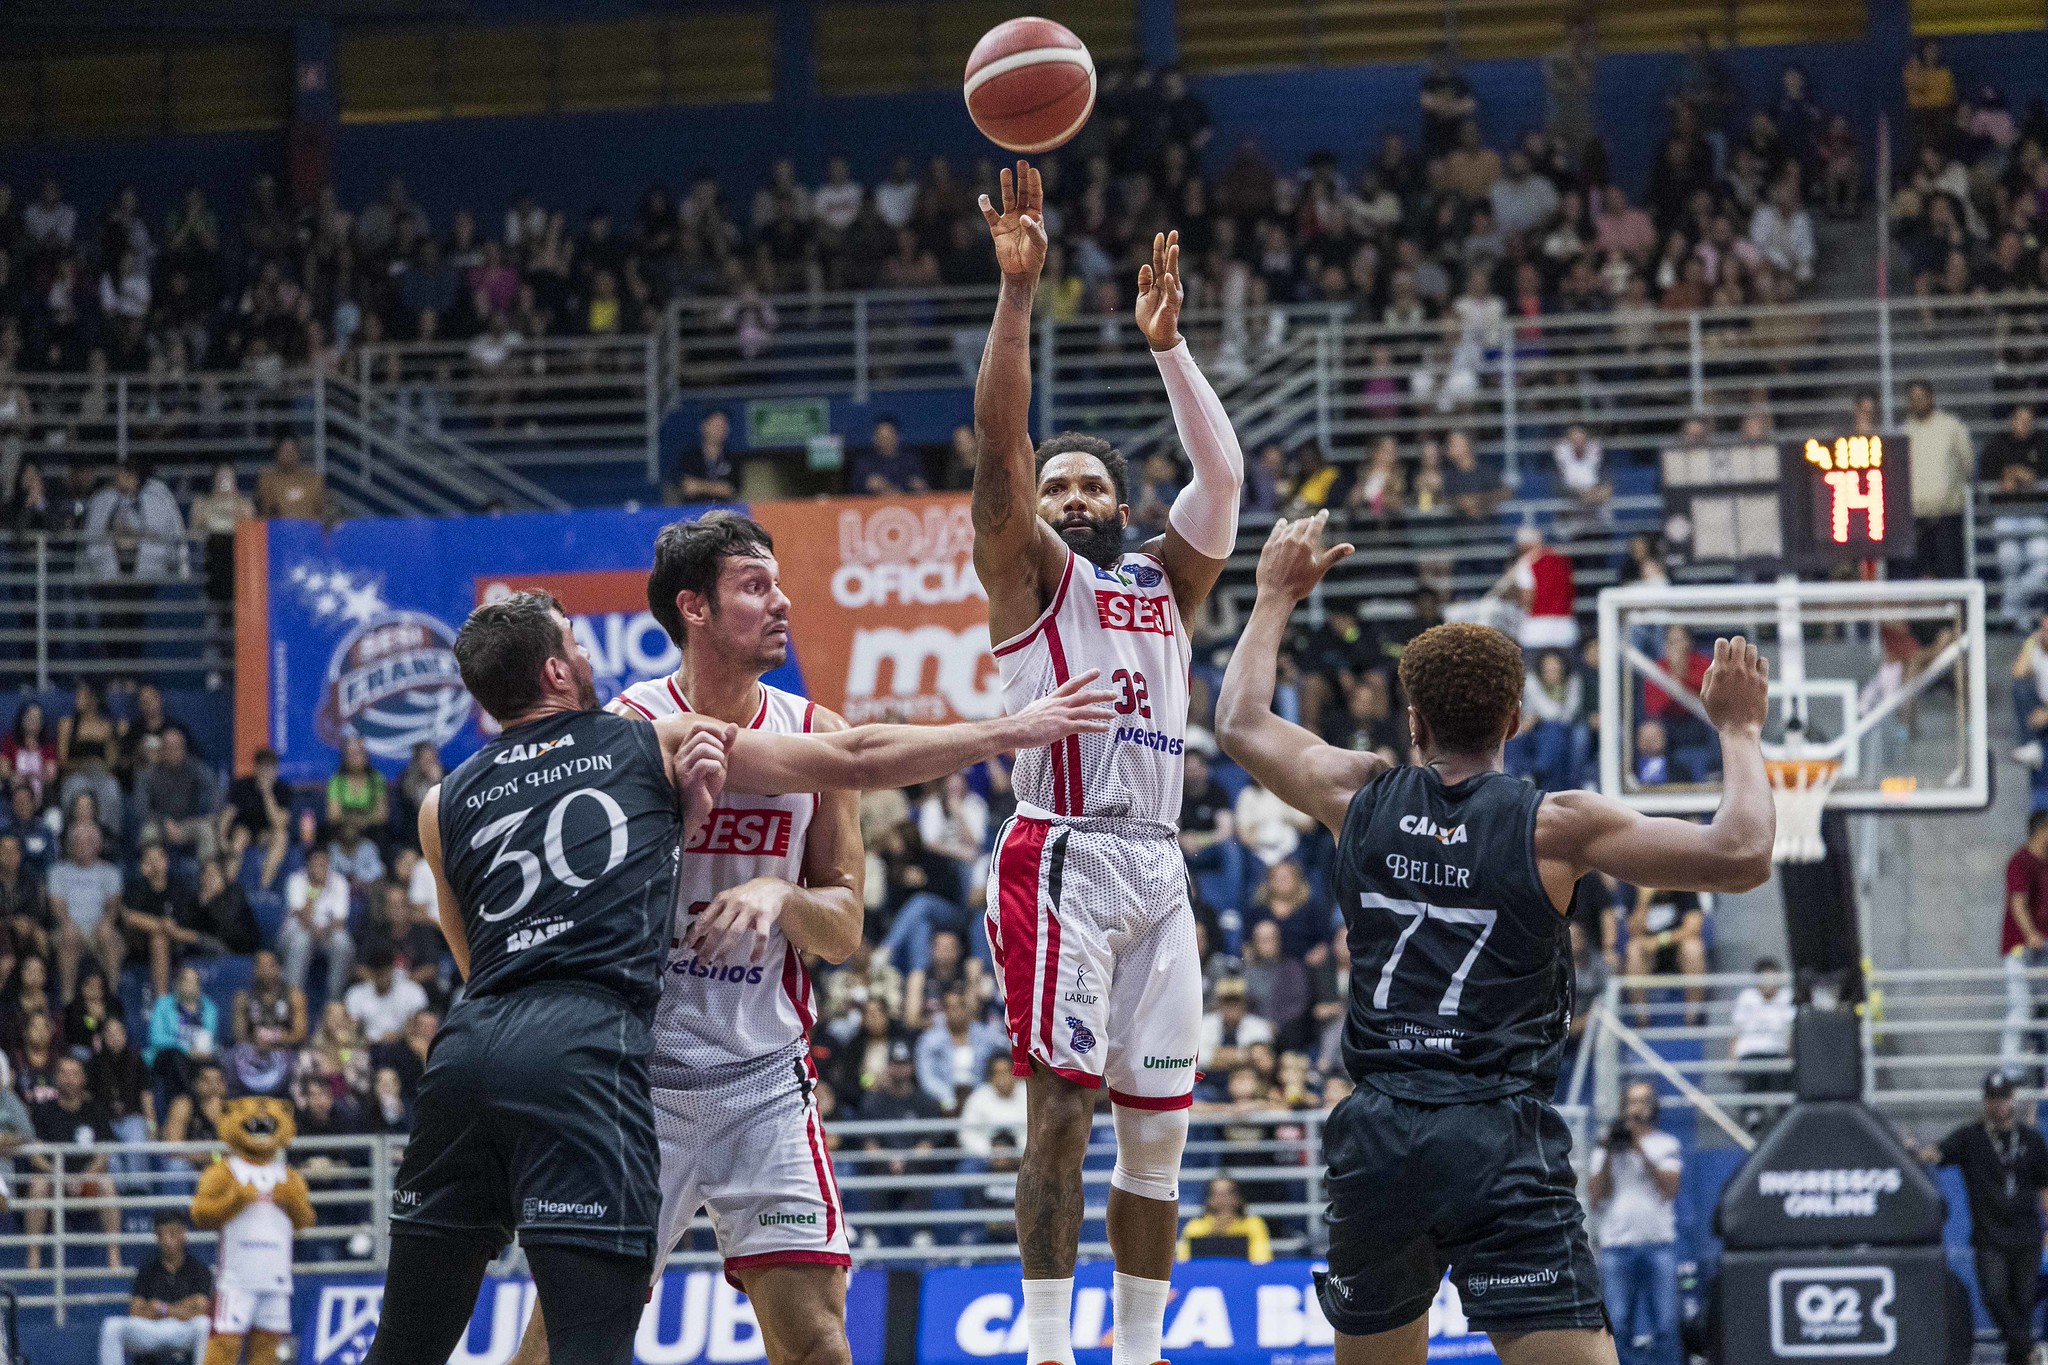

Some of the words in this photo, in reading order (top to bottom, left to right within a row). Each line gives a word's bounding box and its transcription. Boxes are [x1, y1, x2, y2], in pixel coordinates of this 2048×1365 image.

[1825, 469, 1883, 543] 14
[838, 504, 975, 562] LOJA
[831, 561, 989, 608] OFICIA
[1112, 668, 1152, 719] 32
[493, 733, 576, 765] CAIXA
[466, 778, 519, 810] VON
[525, 754, 613, 788] HAYDIN
[687, 814, 780, 851] SESI
[1399, 814, 1468, 845] CAIXA
[470, 787, 629, 922] 30
[1385, 853, 1470, 888] BELLER
[1359, 892, 1498, 1016] 77
[1404, 1021, 1465, 1038] Heavenly
[1758, 1168, 1902, 1196] INGRESSOS
[538, 1200, 608, 1218] Heavenly
[759, 1212, 816, 1226] Unimed
[1783, 1193, 1878, 1218] ONLINE
[1489, 1268, 1559, 1284] Heavenly
[1795, 1284, 1862, 1324] Q2
